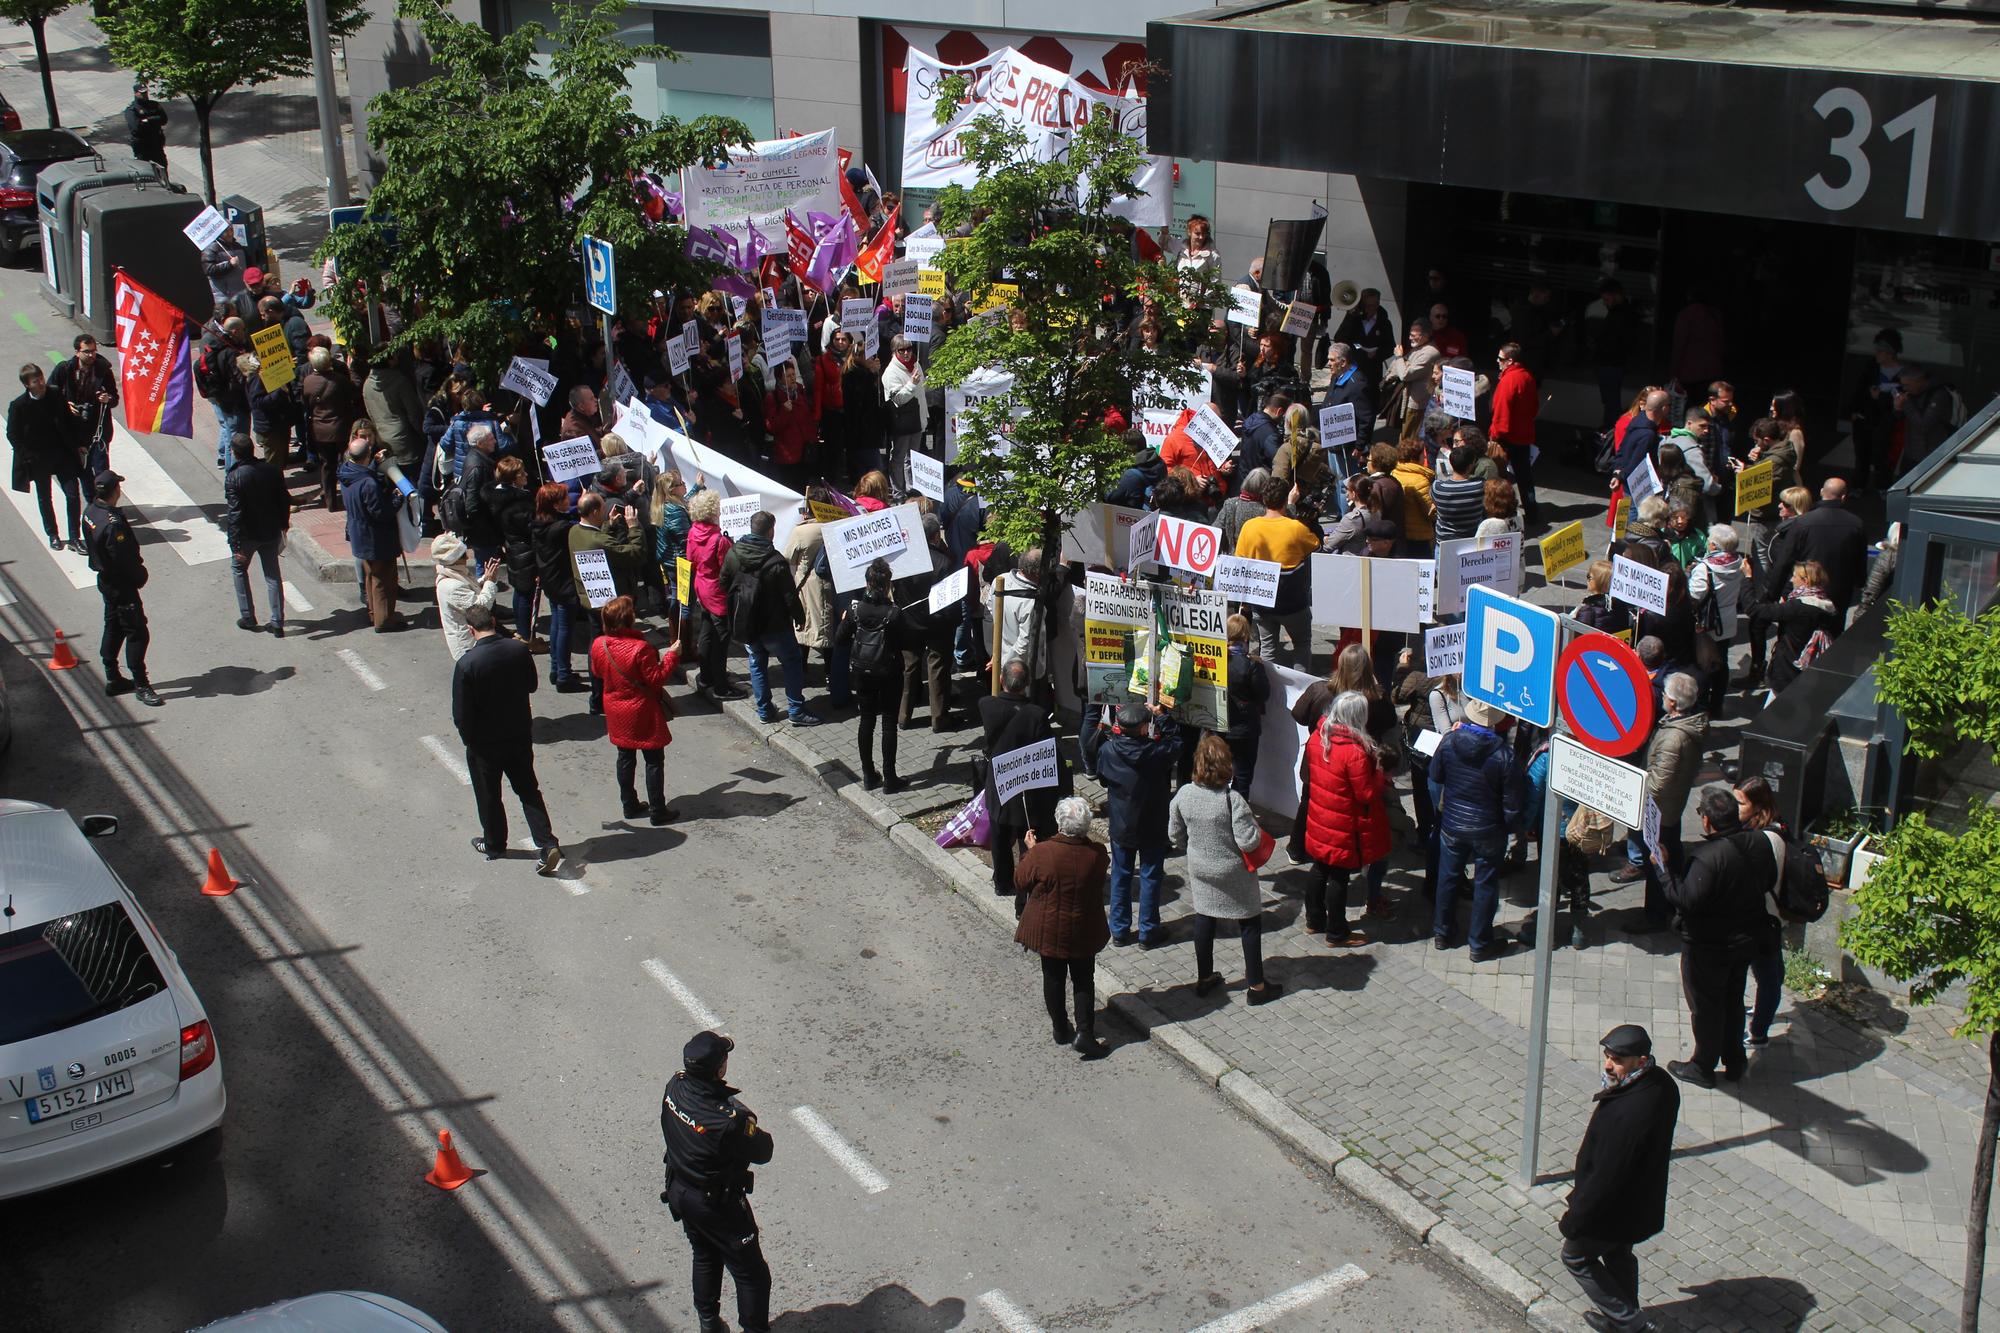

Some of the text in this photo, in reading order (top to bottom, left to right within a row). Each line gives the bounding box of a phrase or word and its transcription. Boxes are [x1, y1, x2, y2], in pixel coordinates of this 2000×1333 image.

[1804, 87, 1936, 219] 31
[746, 172, 758, 180] NO
[744, 178, 831, 193] FALTA DE PERSONAL
[228, 208, 238, 220] P
[764, 215, 785, 226] DIGN
[588, 244, 606, 302] P
[906, 296, 932, 306] SERVICIOS
[906, 310, 931, 320] SOCIALES
[905, 325, 929, 334] DIGNOS.
[254, 329, 282, 346] MALTRATAR
[260, 350, 268, 358] AL
[508, 372, 514, 380] Y
[524, 368, 554, 391] GERIATRAS
[1188, 421, 1196, 431] en
[560, 444, 593, 458] GERIATRAS
[552, 464, 556, 472] Y
[722, 506, 728, 516] NO
[740, 501, 760, 513] MUERTES
[844, 517, 892, 543] MIS MAYORES
[846, 532, 902, 561] SON TUS MAYORES
[1154, 518, 1216, 572] NO
[1494, 540, 1511, 549] NO+
[578, 553, 606, 565] SERVICIOS
[1461, 554, 1494, 568] Derechos
[582, 571, 610, 582] SOCIALES
[1220, 564, 1230, 578] Ley
[1232, 566, 1240, 577] de
[1618, 563, 1662, 591] MIS MAYORES
[1218, 580, 1252, 595] Inspecciones
[1460, 574, 1492, 586] humanos
[588, 588, 614, 599] DIGNOS.
[1090, 580, 1146, 602] PARA PARADOS
[1612, 578, 1664, 609] SON TUS MAYORES
[1214, 595, 1224, 607] LA
[1088, 600, 1148, 620] Y PENSIONISTAS
[1166, 604, 1224, 634] IGLESIA
[1090, 626, 1107, 635] PARA
[1433, 634, 1446, 650] MIS
[1091, 650, 1096, 660] Y
[1480, 606, 1534, 694] P
[1430, 654, 1457, 670] SON TUS
[1497, 682, 1505, 698] 2
[1024, 752, 1031, 765] de
[1032, 744, 1055, 762] calidad
[1569, 748, 1594, 764] EXCEPTO
[998, 764, 1057, 796] en centros de día!
[1579, 763, 1616, 784] AUTORIZADOS
[1568, 776, 1594, 794] SOCIALES
[1602, 792, 1624, 807] FAMILIA
[1595, 780, 1602, 788] DE
[1563, 784, 1627, 818] COMUNIDAD DE MADRID
[104, 1047, 137, 1066] 00005
[40, 1074, 126, 1114] 5152 JVH
[665, 1095, 696, 1128] POLICIA
[75, 1114, 98, 1129] SP
